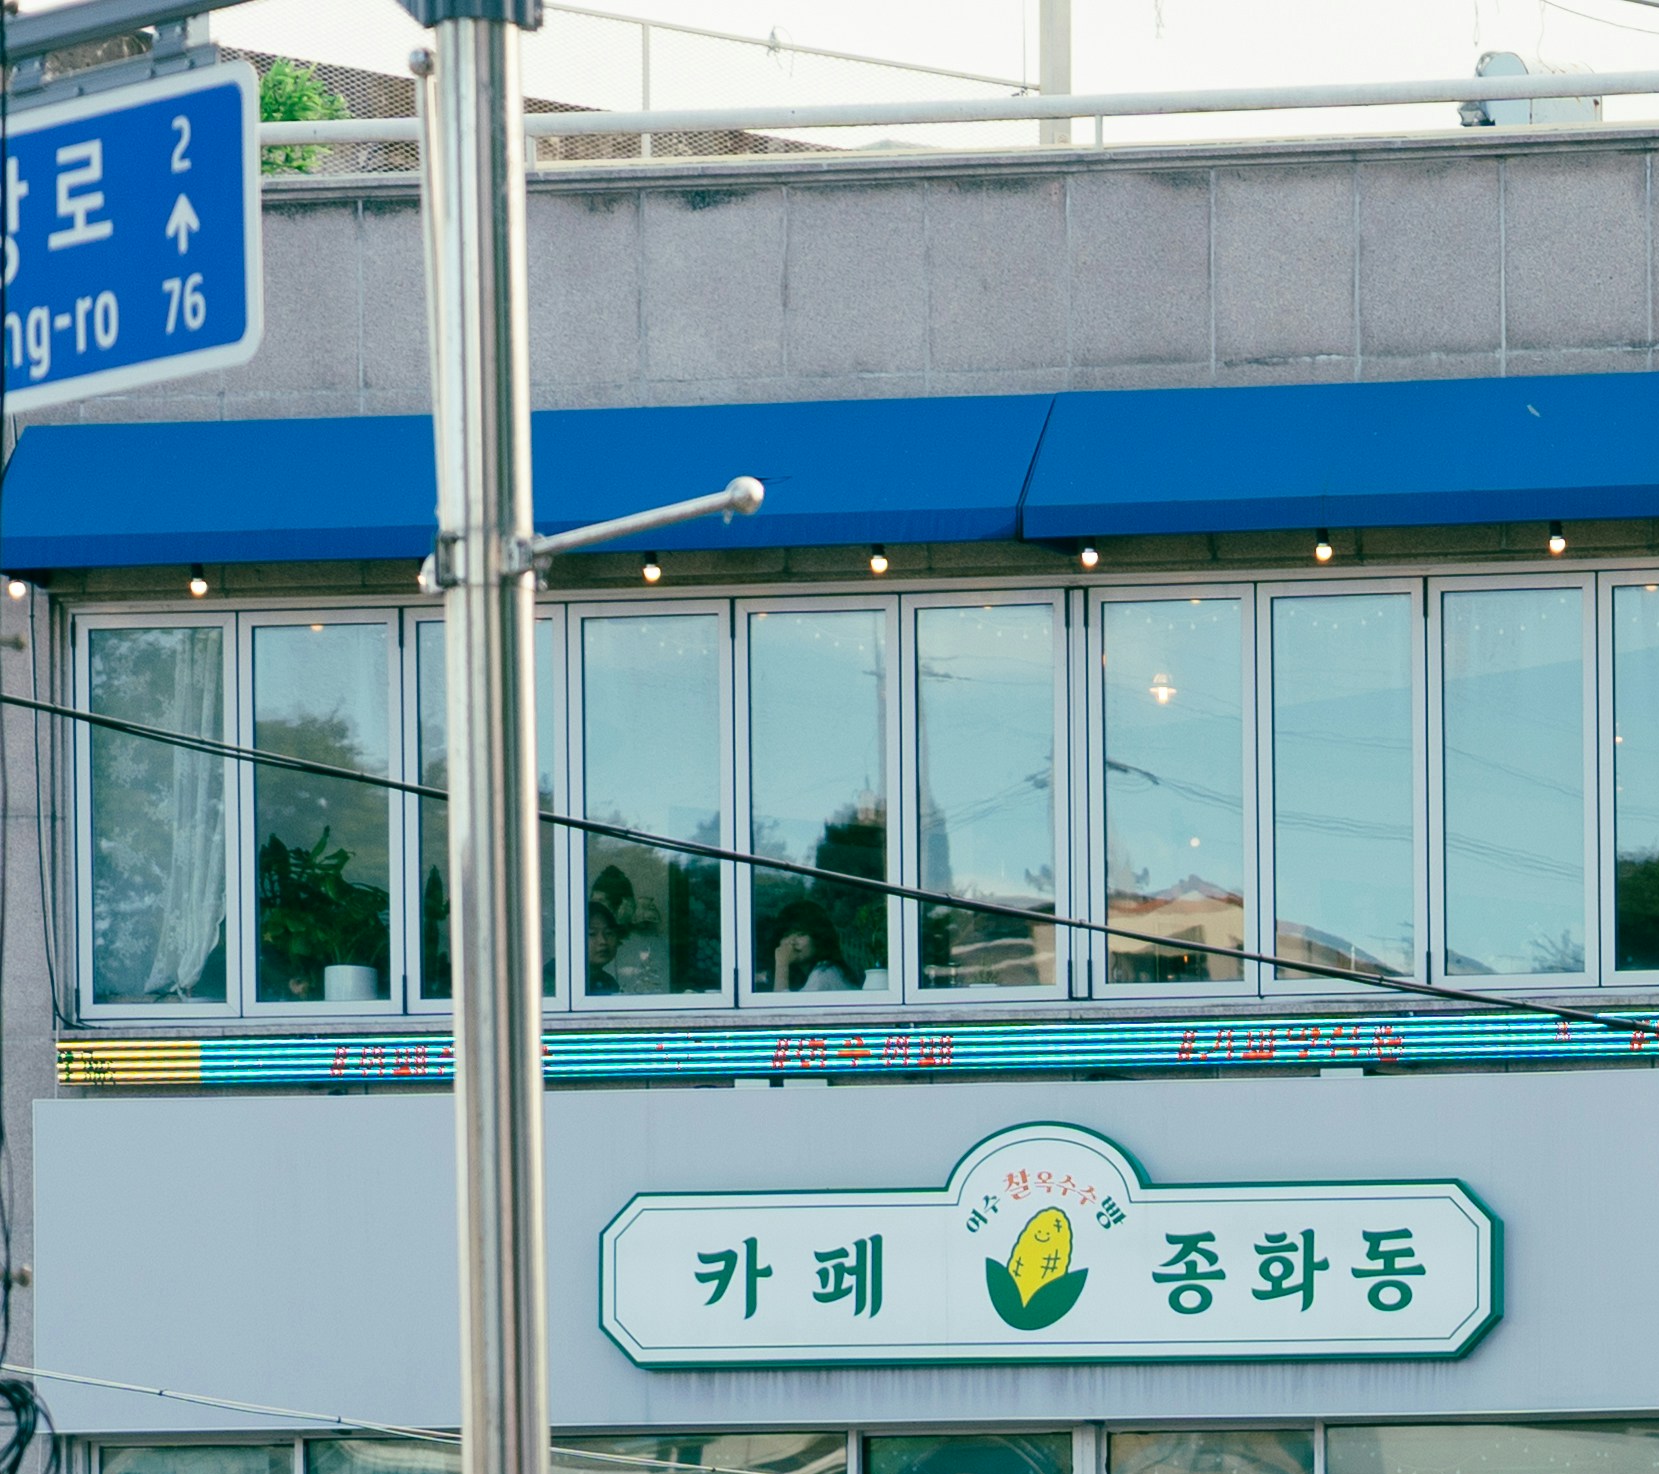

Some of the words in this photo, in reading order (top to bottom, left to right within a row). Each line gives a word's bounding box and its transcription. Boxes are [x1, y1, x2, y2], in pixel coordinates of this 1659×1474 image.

[171, 114, 192, 174] 2
[162, 272, 206, 336] 76
[966, 1194, 1000, 1234] 여수
[694, 1233, 884, 1319] 카페
[1150, 1226, 1428, 1316] 종화동
